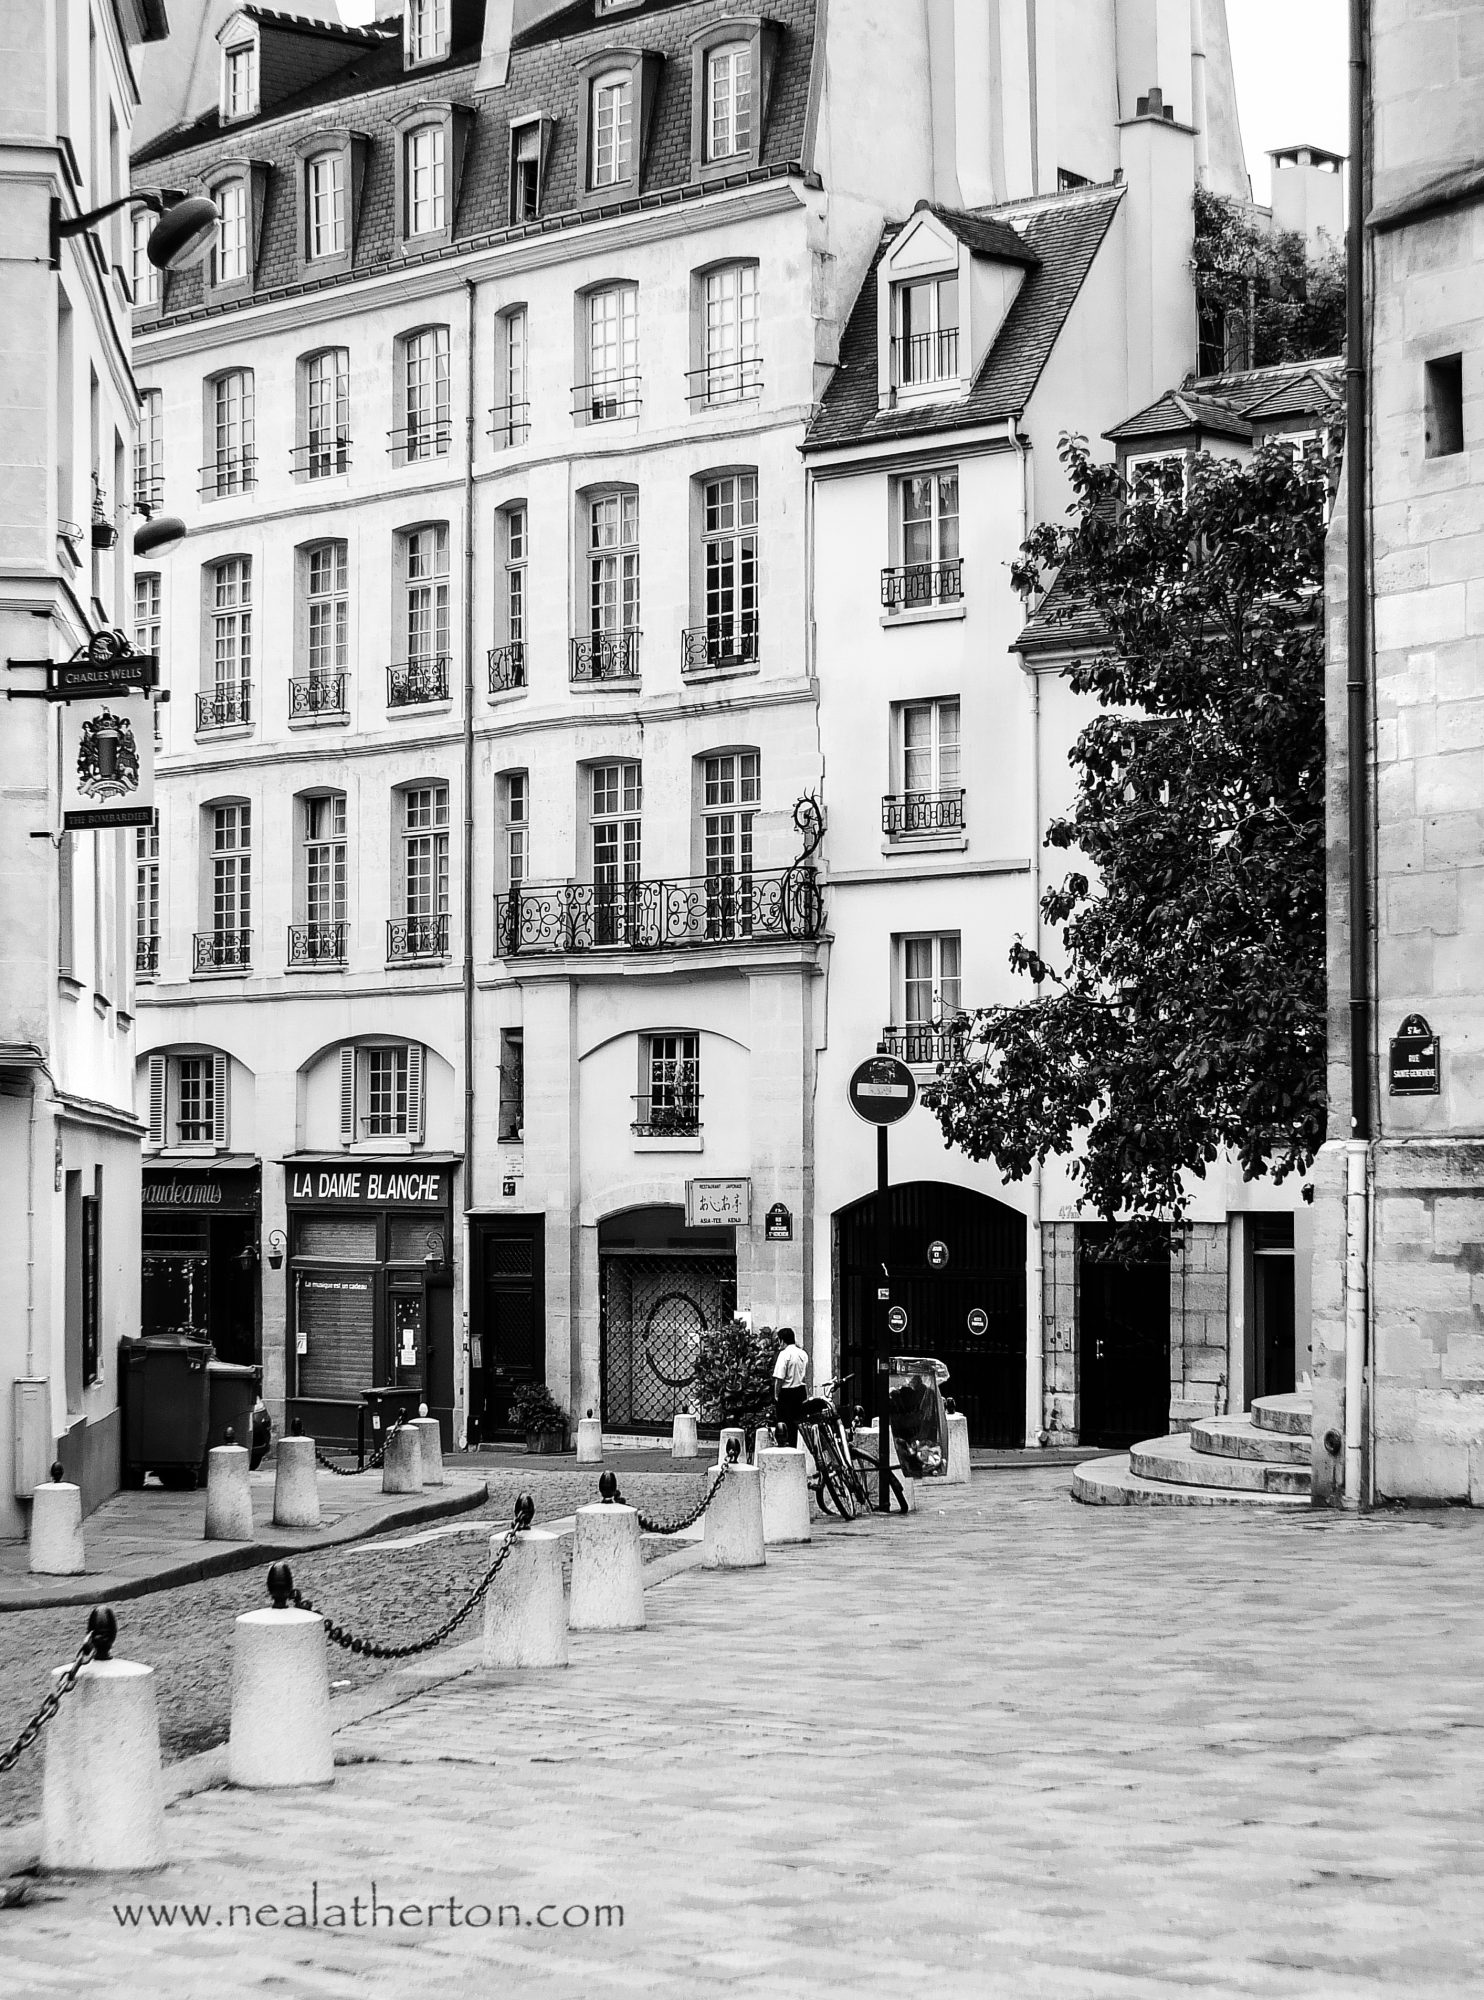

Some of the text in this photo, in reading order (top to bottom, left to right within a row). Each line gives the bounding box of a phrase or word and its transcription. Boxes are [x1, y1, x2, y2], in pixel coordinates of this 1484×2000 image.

[65, 667, 142, 684] CHARLES WELLS
[69, 811, 149, 825] THE BOMBARDIER
[142, 1176, 222, 1204] audeamus
[293, 1173, 440, 1200] LA DAME BLANCHE
